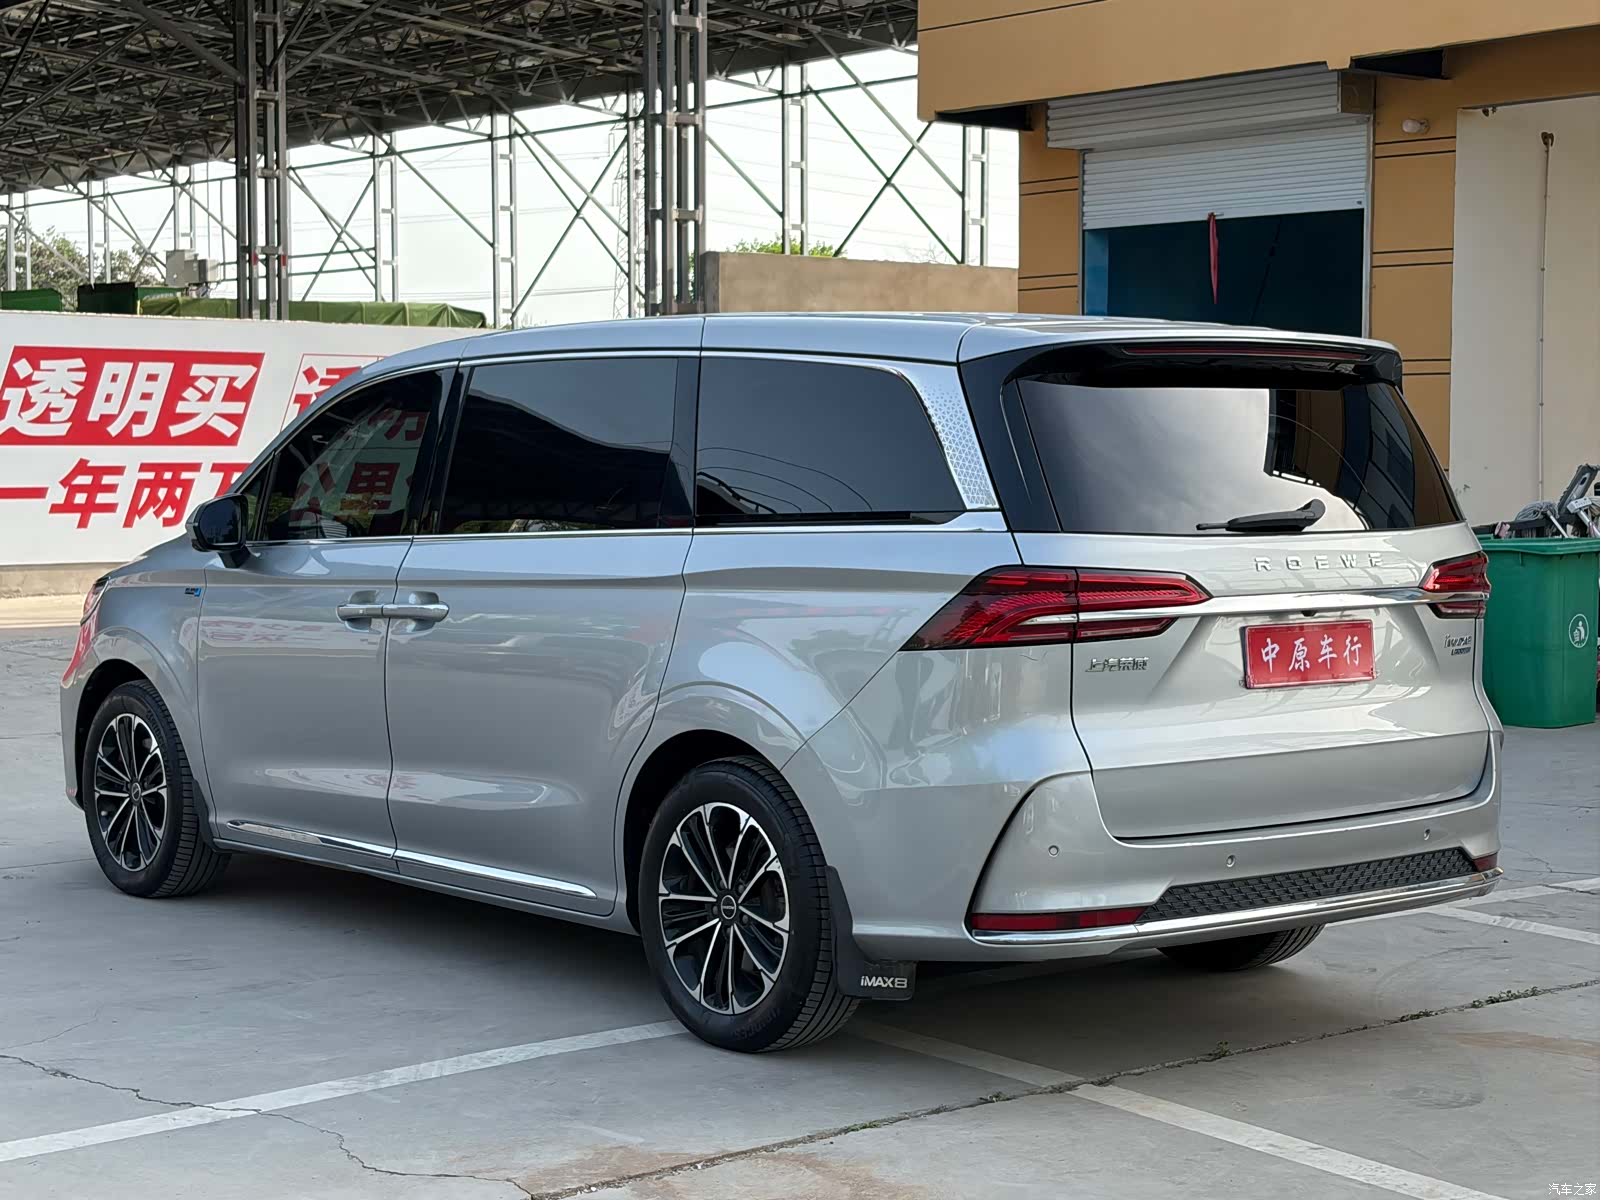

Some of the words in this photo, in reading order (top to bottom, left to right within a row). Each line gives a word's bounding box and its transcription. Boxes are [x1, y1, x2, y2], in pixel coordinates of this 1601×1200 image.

[0, 357, 258, 439] 透明买
[1254, 553, 1383, 573] ROEWE
[1260, 633, 1364, 675] 中原车行
[860, 975, 908, 989] iMAX8
